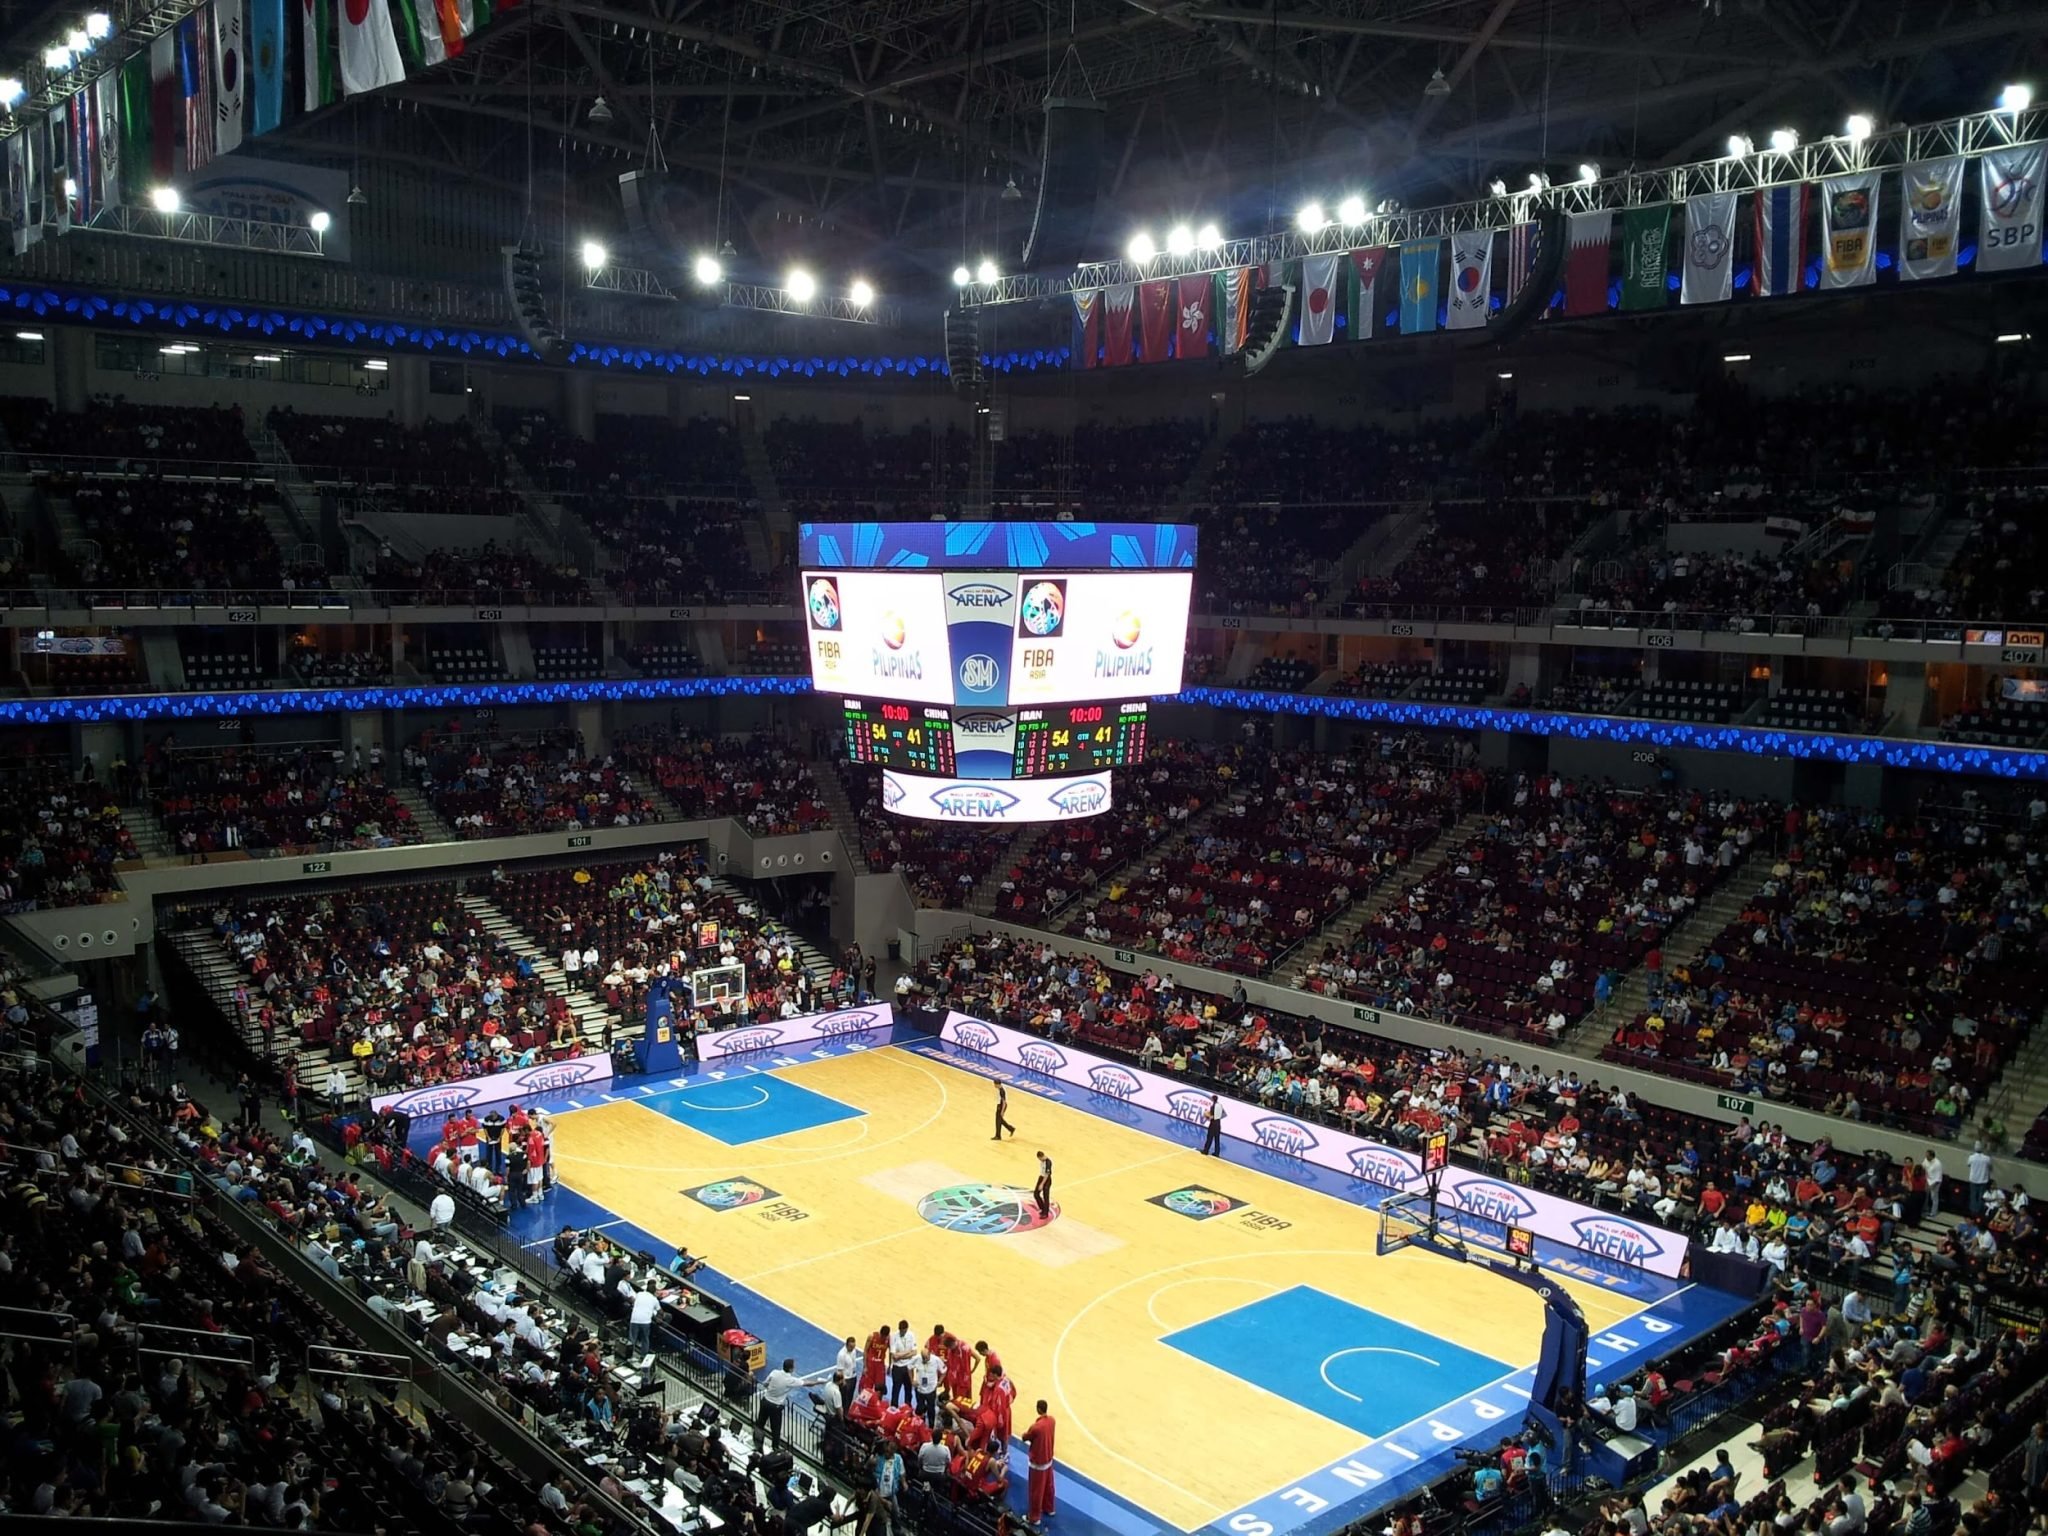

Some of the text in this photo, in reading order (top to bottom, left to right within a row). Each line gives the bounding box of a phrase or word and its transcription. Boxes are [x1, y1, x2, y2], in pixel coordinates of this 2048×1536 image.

[1987, 223, 2034, 248] SBP
[1836, 238, 1862, 253] FIBA
[956, 593, 1003, 607] ARENA
[231, 612, 254, 621] 422
[671, 610, 688, 618] 402
[480, 621, 500, 629] 401
[1224, 619, 1239, 627] 404
[1393, 627, 1411, 635] 405
[1649, 636, 1671, 646] 406
[818, 641, 841, 659] FIBA
[2004, 650, 2034, 663] 407
[872, 648, 922, 680] PILIPINAS
[1023, 649, 1054, 668] FIBA
[1094, 647, 1153, 679] PILIPINAS
[964, 658, 993, 687] SM
[1029, 669, 1047, 680] ASIA
[475, 709, 494, 719] 201
[882, 705, 909, 720] 10:00
[924, 708, 949, 720] CHINA
[1120, 702, 1147, 713] CHINA
[1020, 710, 1043, 721] IRAN
[1070, 707, 1102, 723] 10:00
[219, 720, 241, 730] 222
[872, 723, 887, 740] 54
[962, 721, 1005, 733] ARENA
[1121, 724, 1126, 732] 4
[907, 728, 921, 745] 41
[1021, 732, 1026, 740] 7
[1032, 732, 1037, 740] 3
[1052, 729, 1069, 747] 54
[1095, 726, 1111, 743] 41
[1029, 740, 1036, 748] 12
[1078, 742, 1084, 750] 4
[1017, 749, 1024, 758] 11
[1633, 752, 1655, 763] 206
[1016, 758, 1024, 766] 14
[1048, 761, 1066, 770] 0 3
[1094, 757, 1111, 766] 3 0
[1015, 767, 1023, 775] 15
[941, 799, 1005, 817] ARENA
[1060, 793, 1102, 815] ARENA
[573, 837, 587, 846] 101
[308, 863, 326, 872] 122
[701, 932, 716, 945] 24
[1119, 952, 1132, 962] 105
[1359, 1010, 1376, 1021] 106
[822, 1018, 870, 1036] ARENA
[724, 1034, 774, 1053] ARENA
[955, 1029, 989, 1053] ARENA
[1020, 1050, 1057, 1075] ARENA
[528, 1070, 584, 1092] ARENA
[1090, 1073, 1132, 1100] ARENA
[407, 1094, 469, 1115] ARENA
[1724, 1097, 1747, 1111] 107
[1169, 1099, 1210, 1125] AREN
[1255, 1127, 1304, 1157] ARENA
[1427, 1147, 1444, 1169] 24
[1352, 1157, 1406, 1190] ARENA
[764, 1202, 810, 1222] FIBA
[1459, 1191, 1518, 1226] ARENA
[1241, 1211, 1293, 1231] FIBA
[1595, 1224, 1610, 1232] MALL
[1620, 1229, 1640, 1241] ASIA
[1510, 1239, 1529, 1254] 24
[1579, 1228, 1643, 1267] ARENA
[876, 1349, 882, 1357] 7
